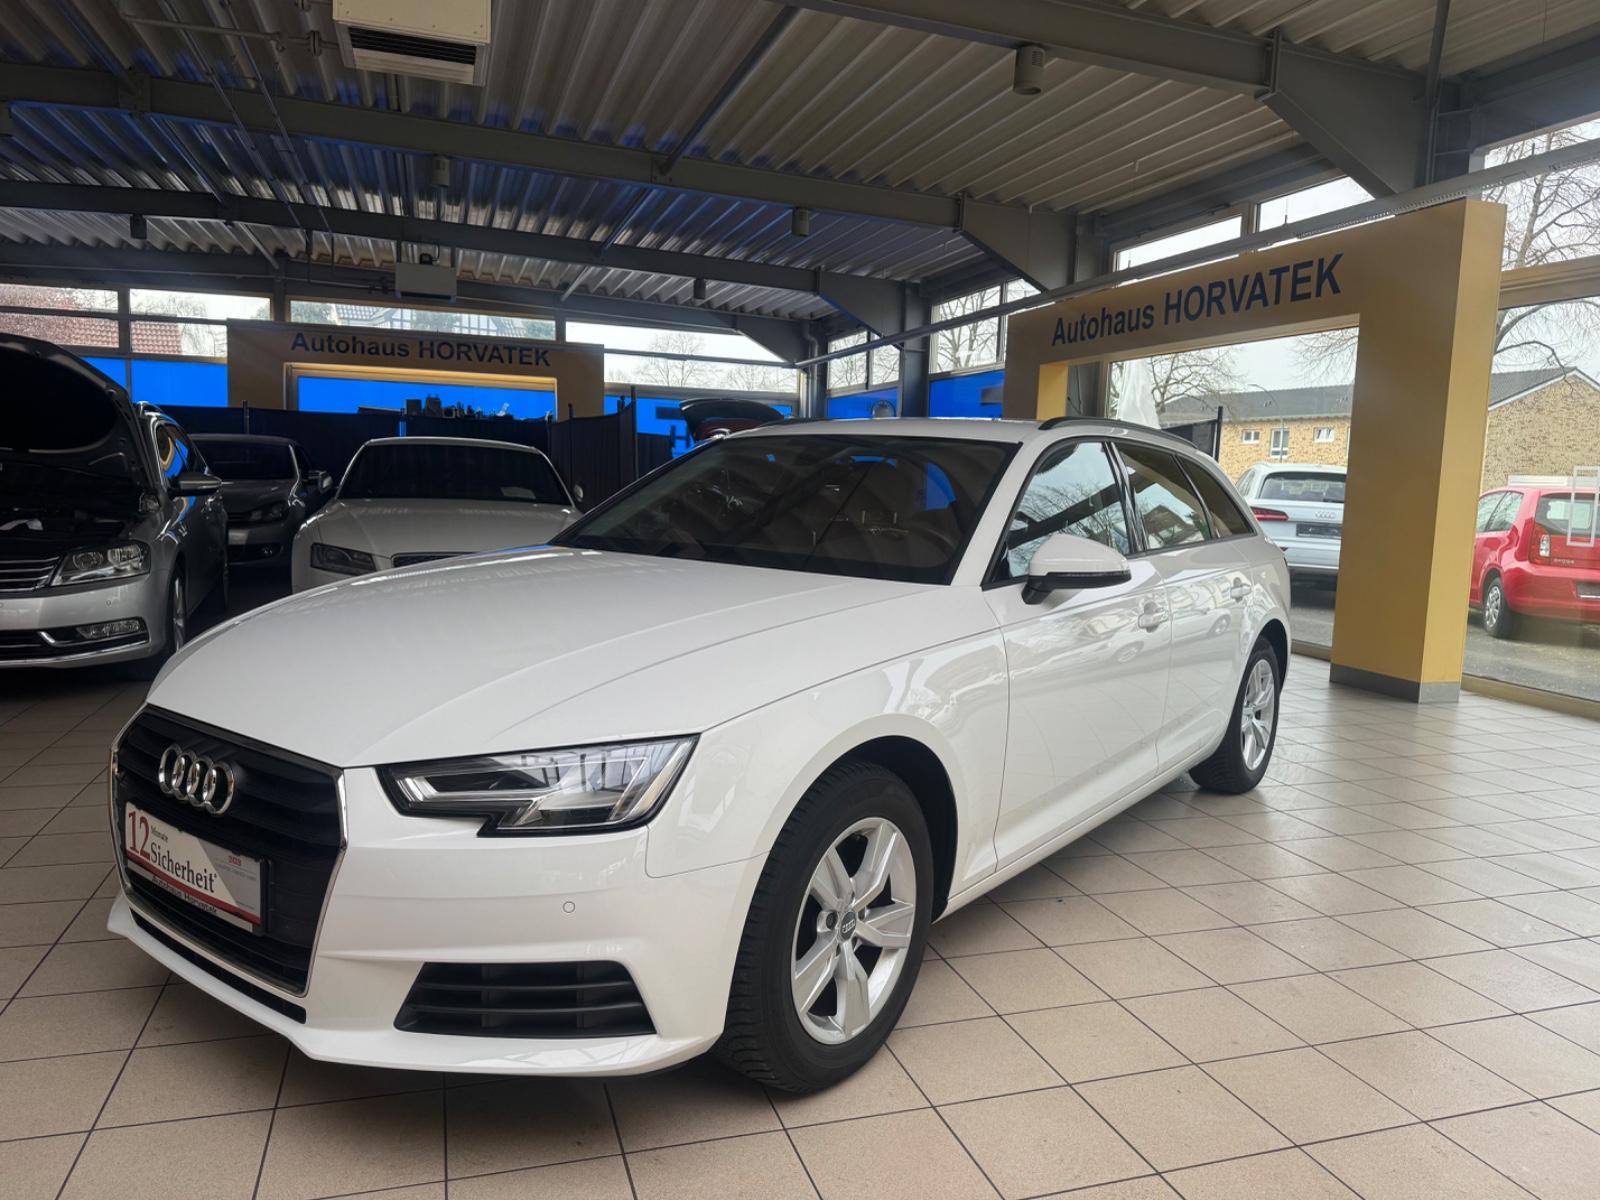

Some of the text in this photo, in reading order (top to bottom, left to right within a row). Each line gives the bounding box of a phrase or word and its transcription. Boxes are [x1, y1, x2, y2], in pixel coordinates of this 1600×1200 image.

[1052, 253, 1343, 347] Autohaus HORVATEK
[291, 332, 551, 367] Autohaus HORVATEK
[128, 810, 151, 862] 12
